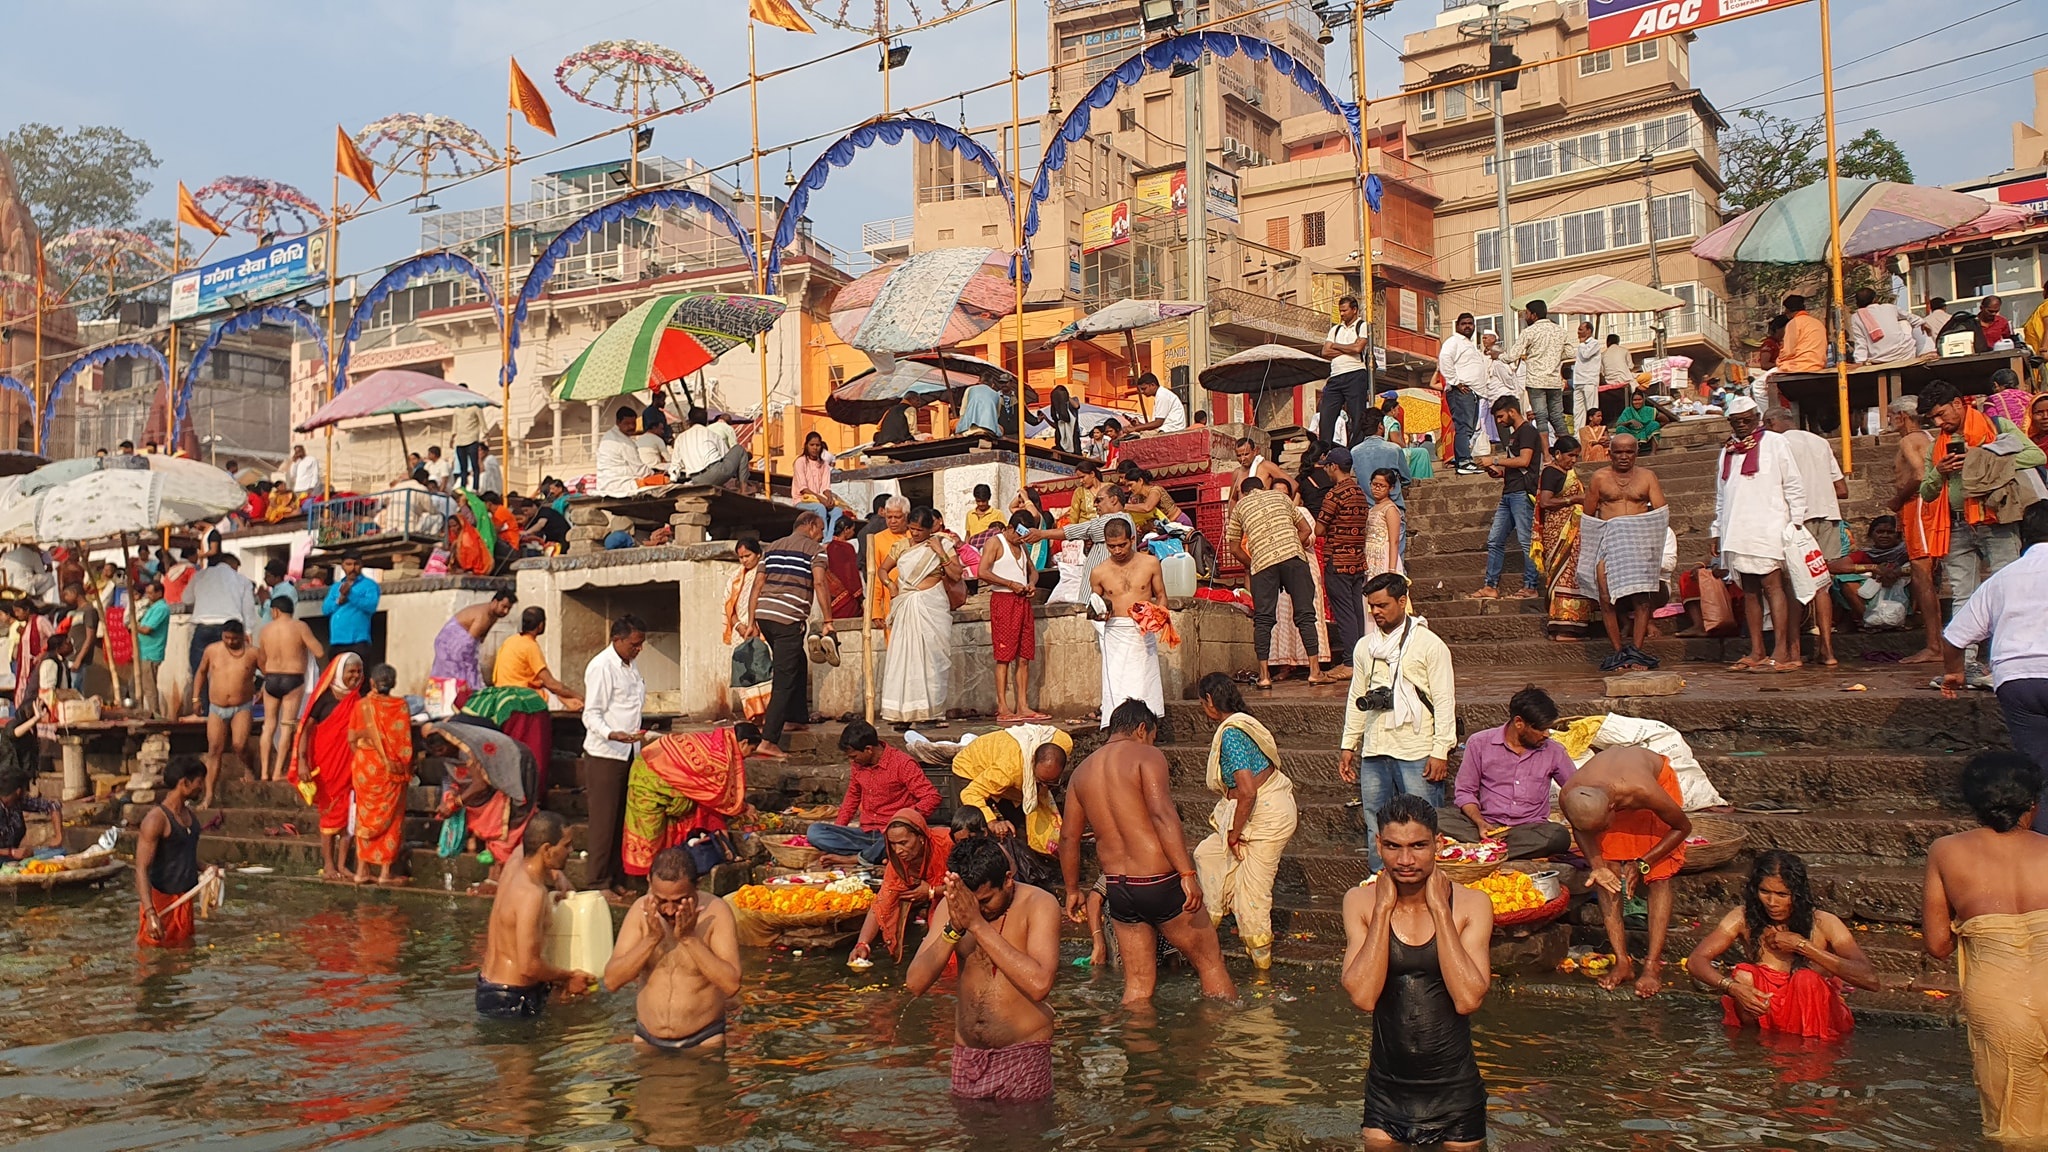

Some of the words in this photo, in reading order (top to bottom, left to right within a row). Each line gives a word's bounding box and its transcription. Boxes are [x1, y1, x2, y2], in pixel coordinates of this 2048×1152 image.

[1629, 0, 1702, 39] ACC
[203, 267, 236, 286] गंगा
[237, 257, 267, 277] सेवा
[269, 243, 305, 268] निधि
[1164, 346, 1189, 360] PANDE
